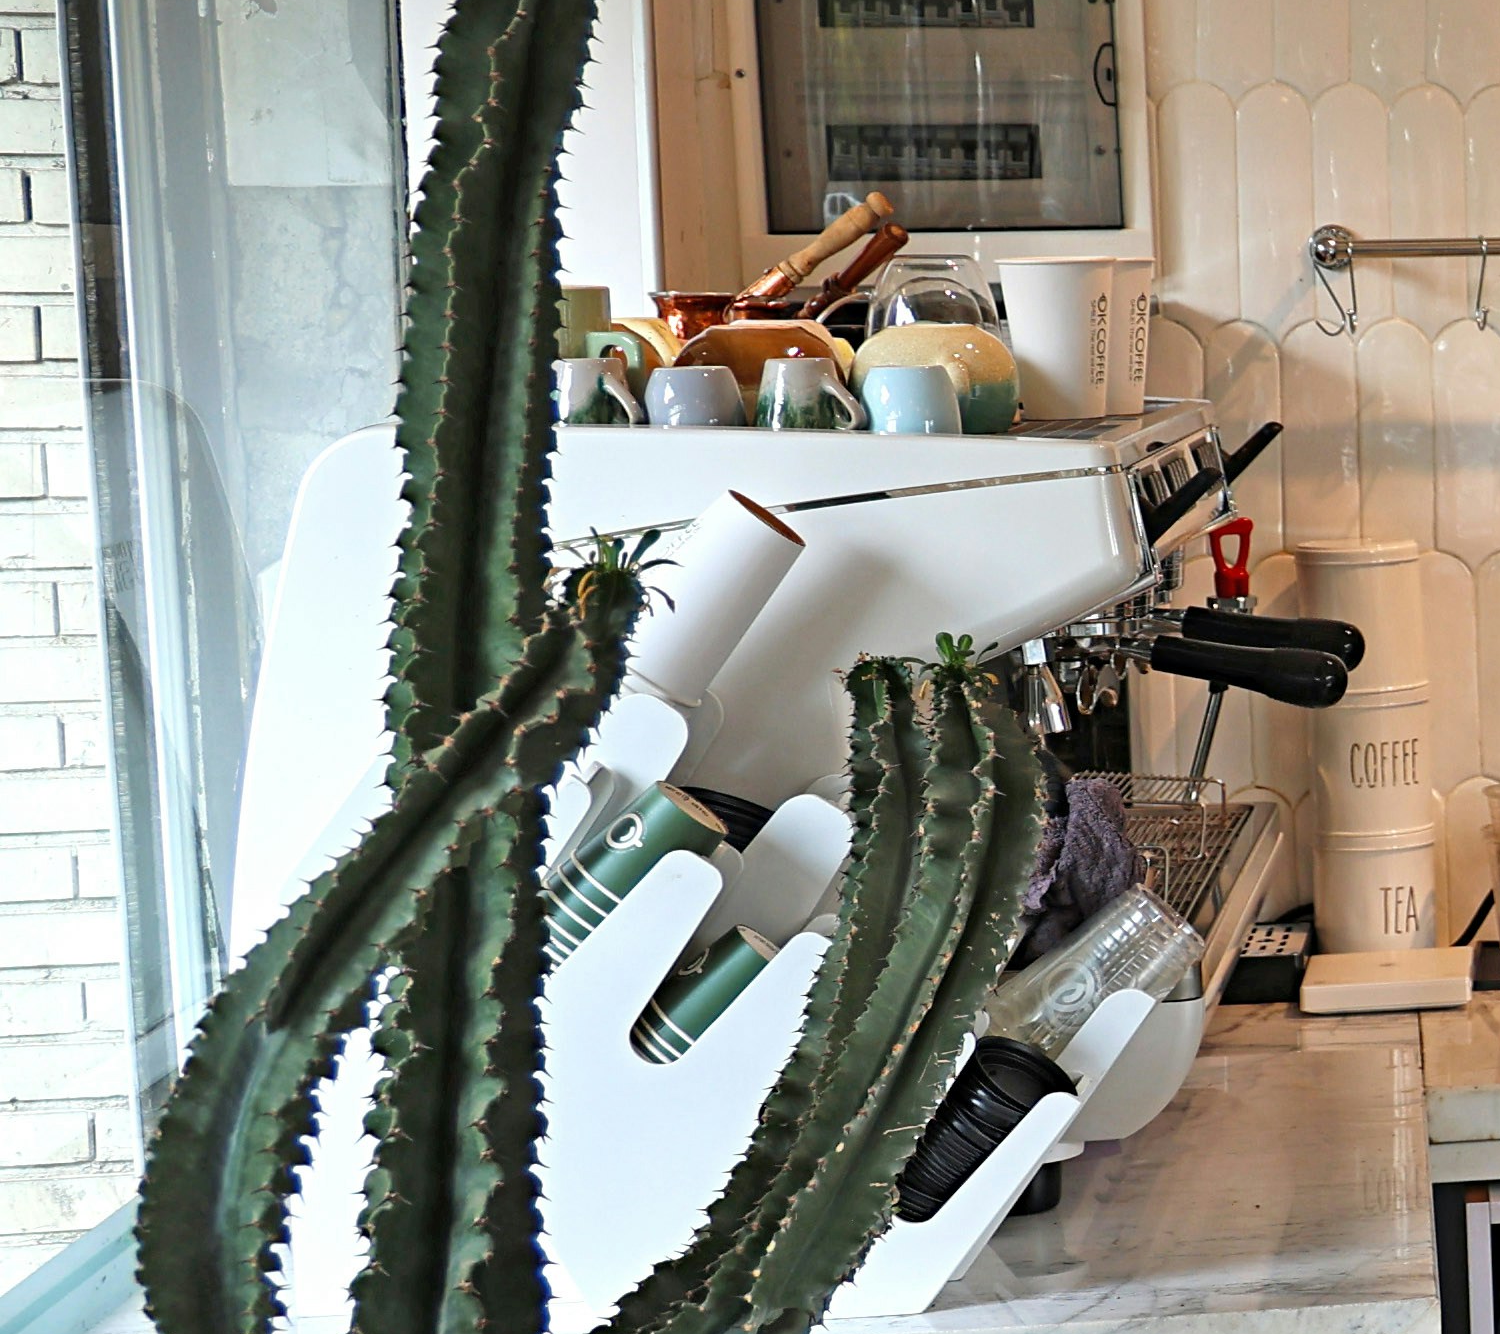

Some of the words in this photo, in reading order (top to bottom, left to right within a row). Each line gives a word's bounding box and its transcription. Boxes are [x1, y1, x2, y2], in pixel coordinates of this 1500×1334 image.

[1097, 292, 1108, 325] OK
[1136, 292, 1147, 325] OK
[1095, 328, 1106, 386] COFFEE
[1133, 327, 1145, 383] COFFEE
[1350, 737, 1419, 789] COFFEE
[1379, 885, 1420, 935] TEA
